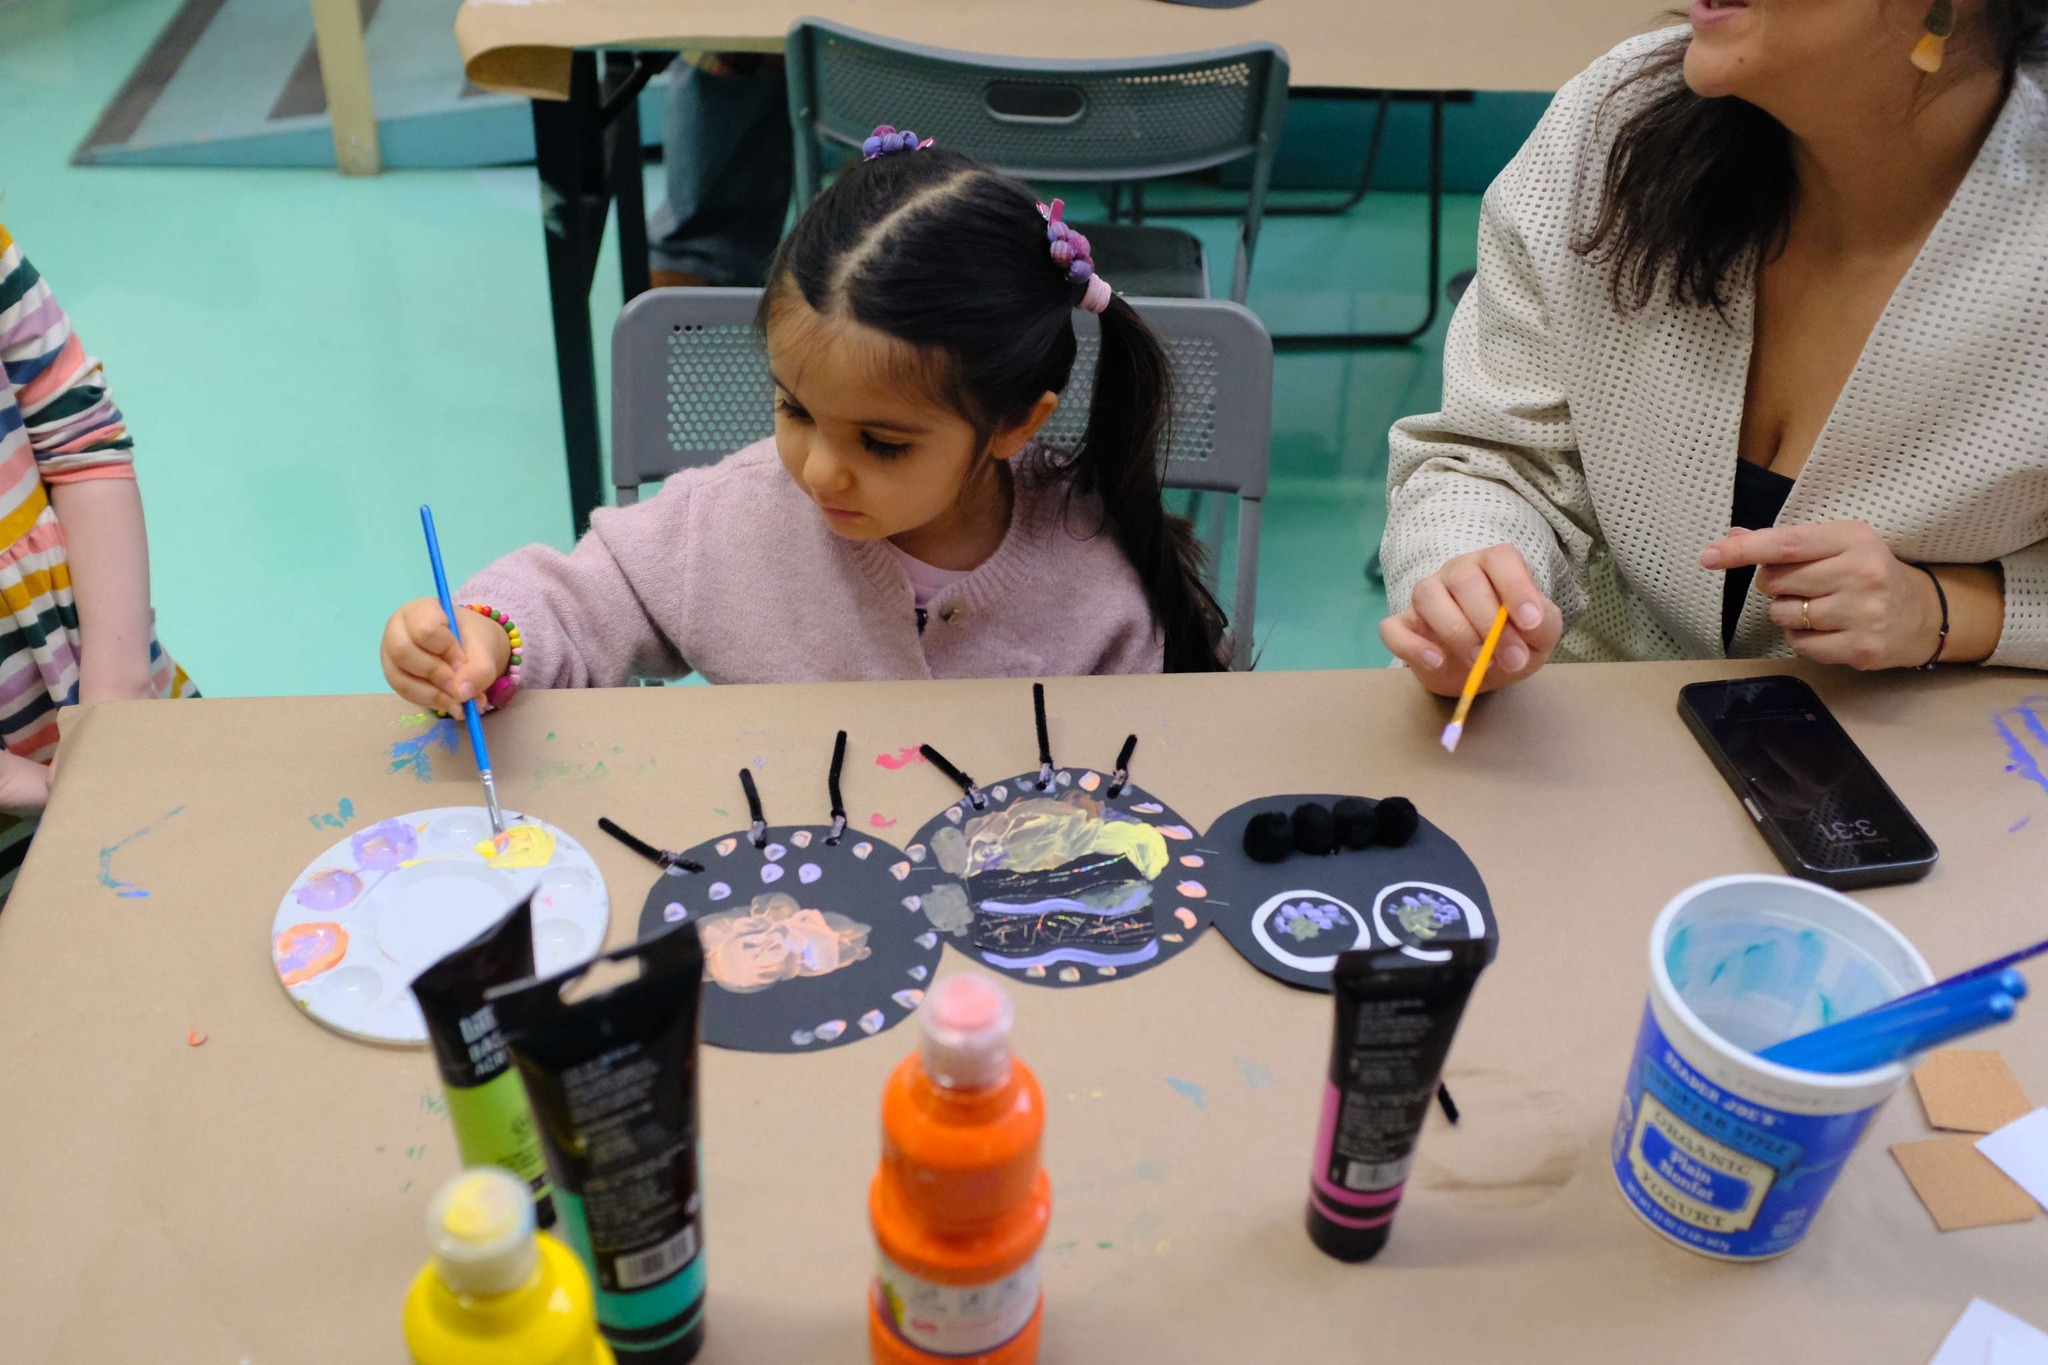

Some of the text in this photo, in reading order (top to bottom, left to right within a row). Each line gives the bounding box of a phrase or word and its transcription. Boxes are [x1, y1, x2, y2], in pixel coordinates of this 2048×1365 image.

[1819, 819, 1878, 840] 3:31
[1654, 1109, 1751, 1176] ORGANIC
[1658, 1158, 1715, 1202] Nonfat
[1669, 1149, 1712, 1184] Plain
[1641, 1166, 1726, 1227] YOGURT
